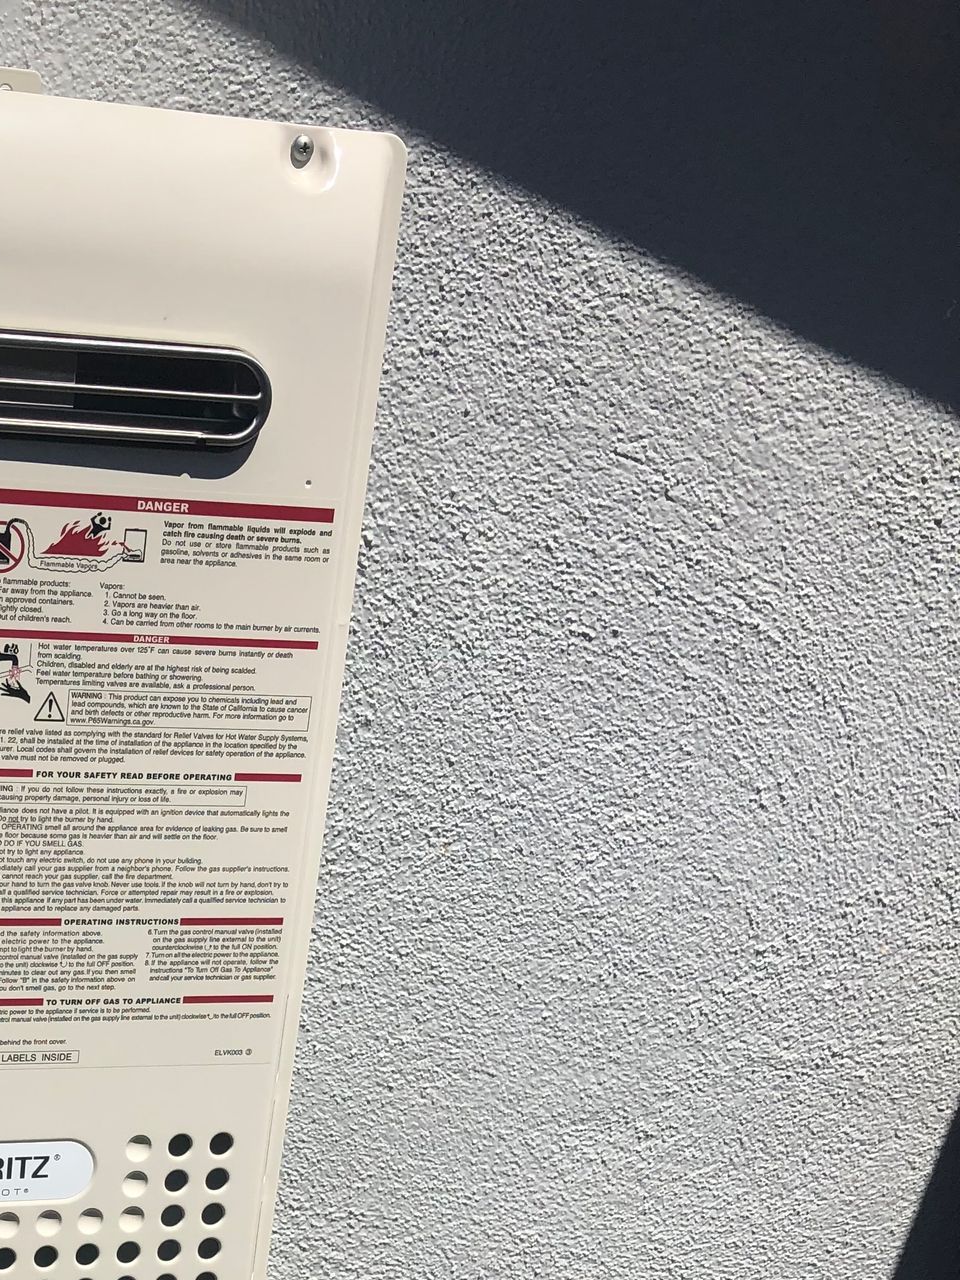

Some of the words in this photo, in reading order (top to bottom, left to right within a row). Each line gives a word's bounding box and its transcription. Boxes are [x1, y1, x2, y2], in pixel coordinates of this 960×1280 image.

[137, 500, 189, 512] DANGER
[163, 520, 184, 529] Vapor
[207, 522, 243, 531] flammable
[246, 525, 270, 534] liquids
[273, 526, 286, 534] will
[288, 527, 316, 537] explode
[162, 529, 182, 537] catch
[183, 530, 195, 538] fire
[196, 531, 224, 541] causing
[225, 532, 245, 540] death
[39, 560, 74, 568] Flammable
[76, 561, 99, 571] Vapors
[2, 577, 38, 585] flammable
[99, 582, 125, 590] Vapors:
[133, 635, 169, 643] DANGER
[74, 644, 117, 653] temperatures
[238, 650, 265, 659] instantly
[146, 772, 180, 780] BEFORE
[20, 930, 40, 938] safety
[1, 1053, 36, 1062] LABELS
[41, 1052, 72, 1061] INSIDE
